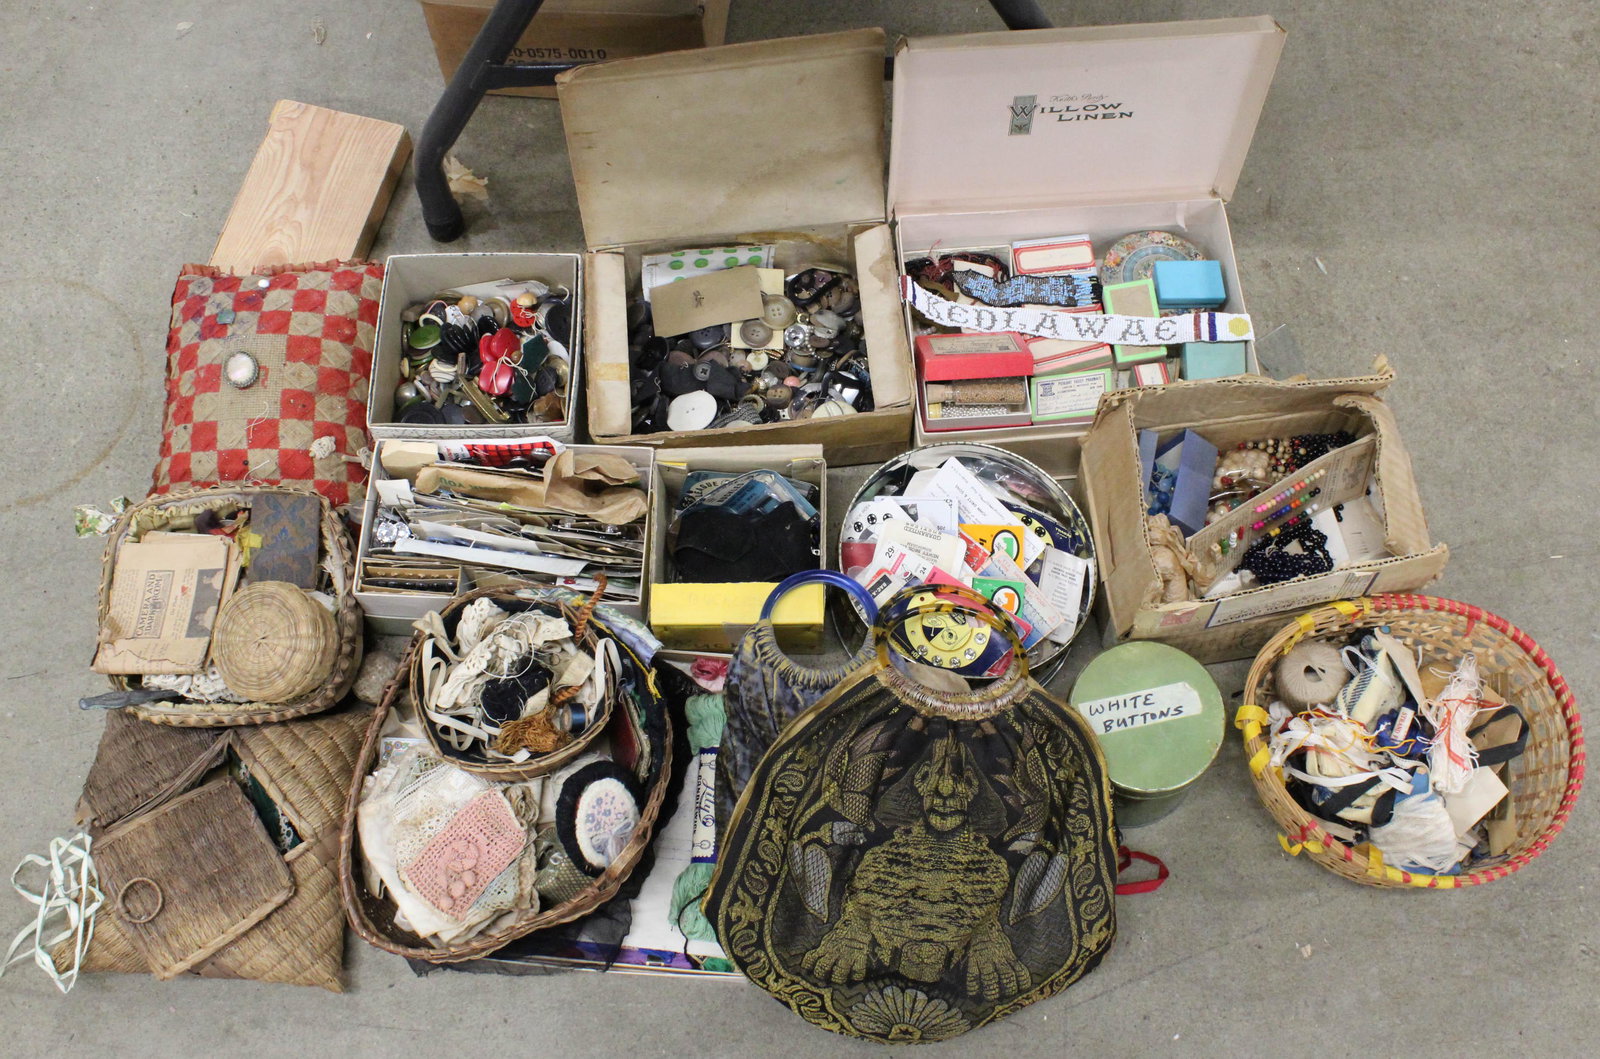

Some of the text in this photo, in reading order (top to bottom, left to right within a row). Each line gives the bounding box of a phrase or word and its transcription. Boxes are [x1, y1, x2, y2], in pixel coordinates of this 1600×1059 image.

[510, 47, 606, 59] 0-0575-0010
[1008, 102, 1123, 120] WILLOW
[1056, 111, 1134, 122] LINEN
[136, 573, 156, 636] CAMERA AND
[144, 577, 163, 631] DARK ROOM
[1088, 692, 1156, 716] WHITE
[1102, 705, 1185, 734] BUTTONS
